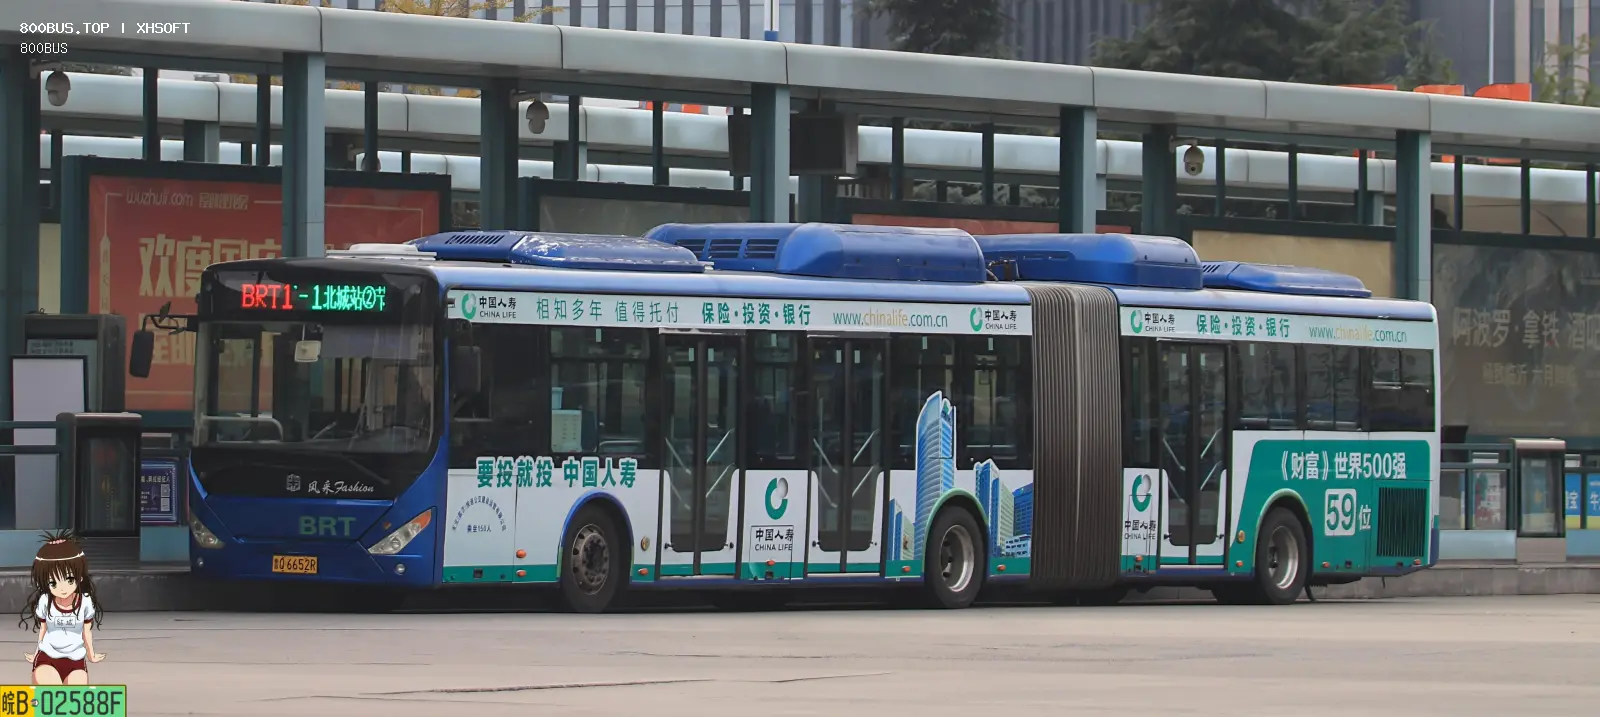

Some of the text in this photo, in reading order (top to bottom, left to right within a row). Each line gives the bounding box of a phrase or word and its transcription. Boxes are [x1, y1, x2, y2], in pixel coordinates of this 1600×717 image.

[479, 295, 517, 310] 中国人寿
[536, 297, 679, 323] 相知多年 值得托付
[479, 310, 517, 319] CHINA LIFE
[832, 307, 948, 328] www.chinalife.com.cn
[984, 309, 1018, 323] 中国人寿
[1144, 311, 1176, 325] 中国人寿
[985, 322, 1017, 330] CHINA LIFE
[1144, 324, 1176, 333] CHINA LIFE
[1308, 324, 1408, 343] www.chinalife.com.cn
[476, 458, 637, 489] 要投就投 中国人寿
[1325, 492, 1372, 531] 59 位
[298, 515, 357, 537] BRT
[1124, 519, 1157, 532] 中国人寿
[755, 527, 795, 542] 中国人寿
[754, 543, 793, 551] CHINA LIFE
